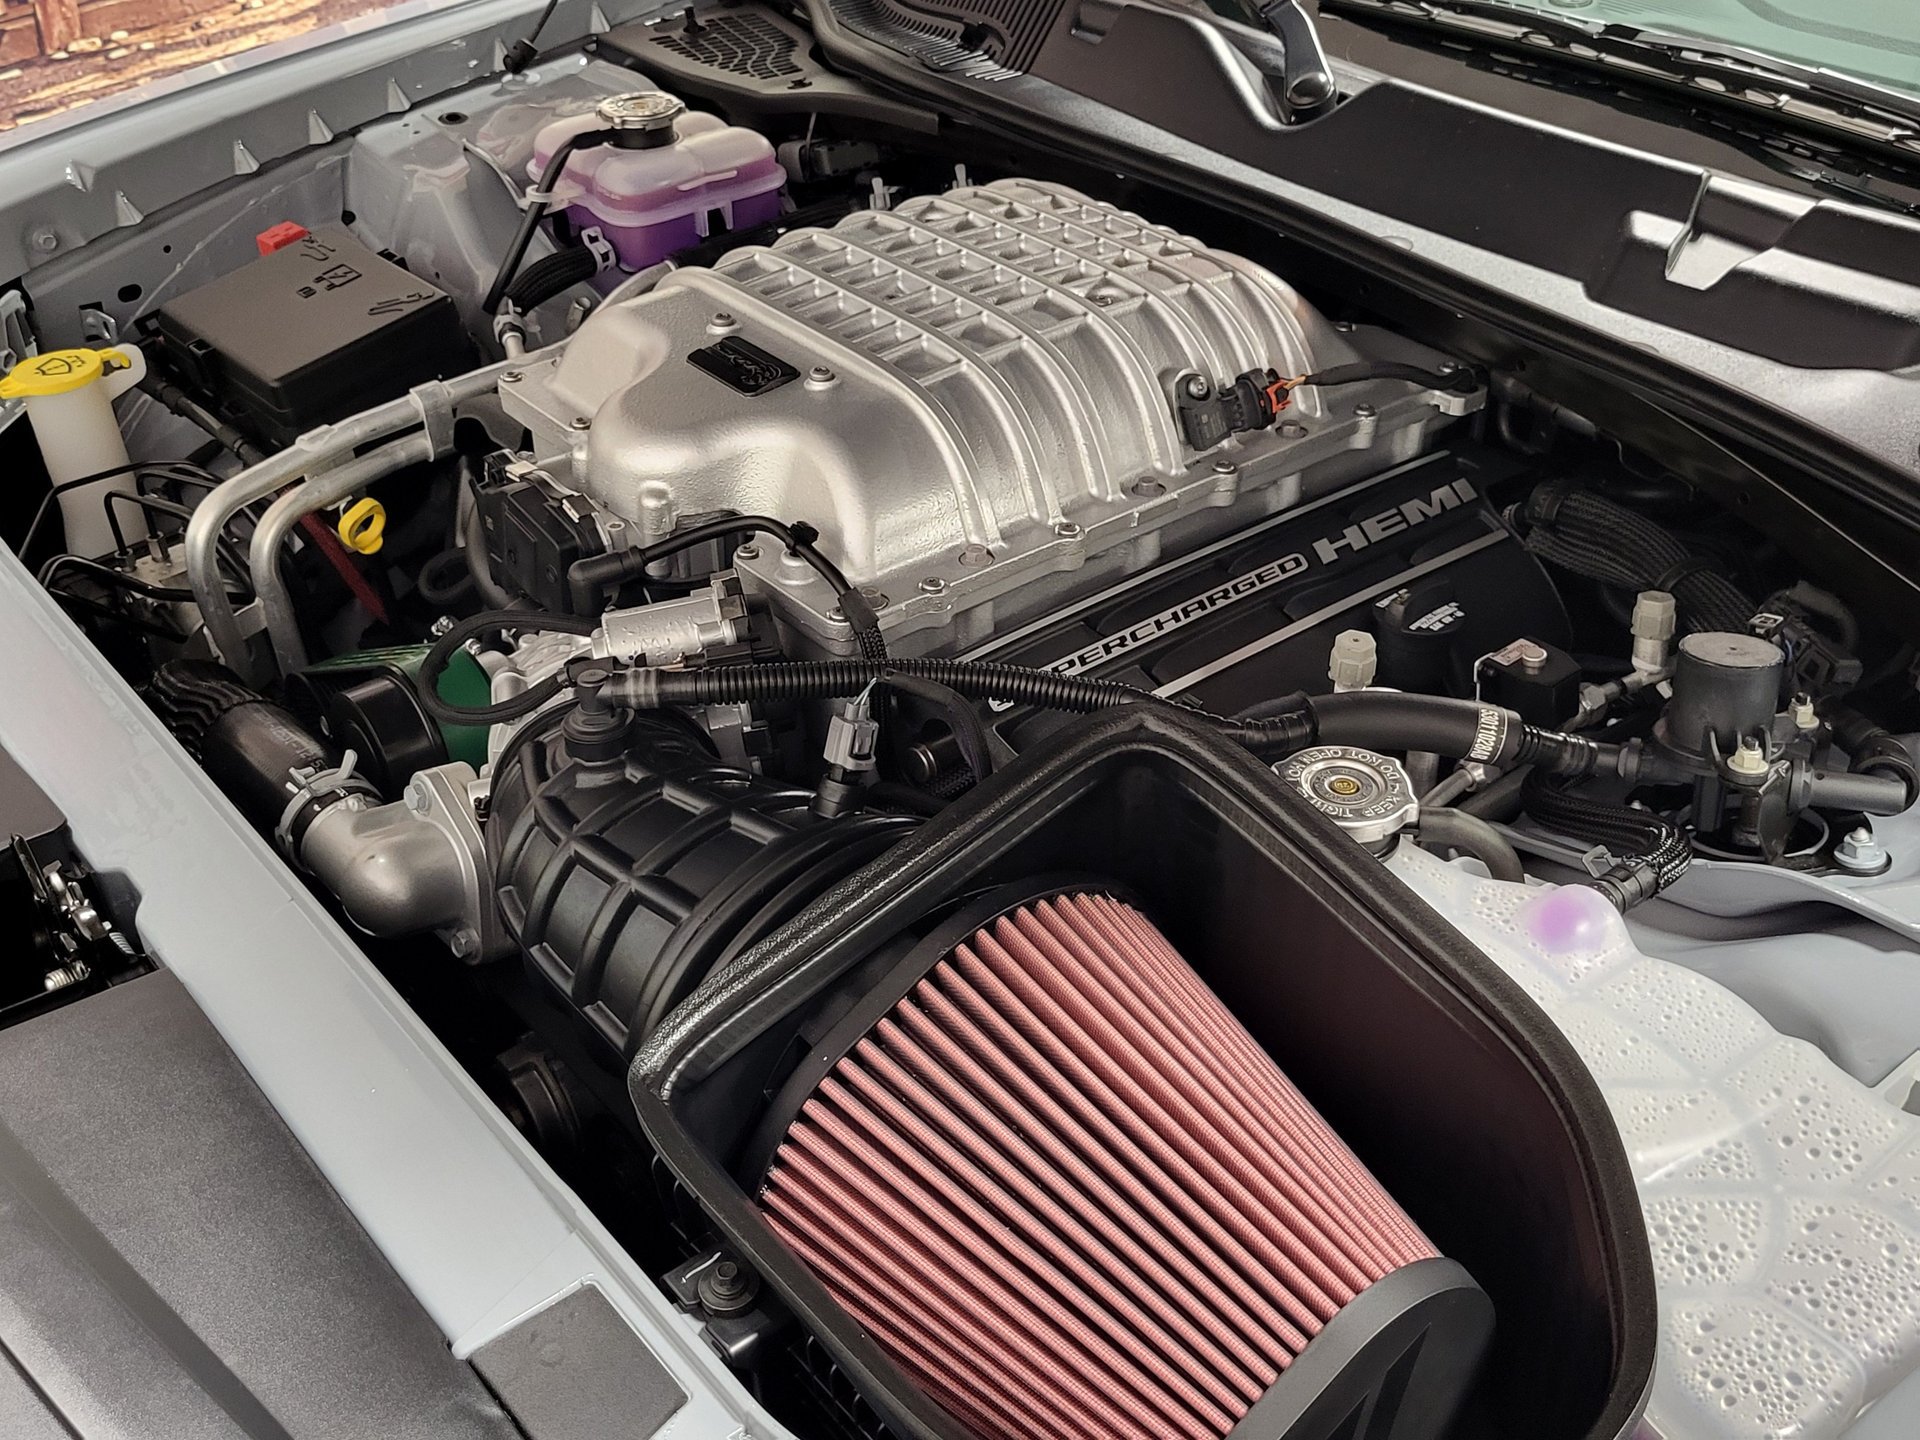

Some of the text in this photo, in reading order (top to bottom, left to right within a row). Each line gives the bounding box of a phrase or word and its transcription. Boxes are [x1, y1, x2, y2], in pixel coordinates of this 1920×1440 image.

[1050, 477, 1478, 673] PERCHARGED HEMI
[1301, 749, 1342, 764] OPEN
[1351, 750, 1382, 766] NOT
[1380, 765, 1400, 780] DO
[1362, 795, 1401, 817] KEEP
